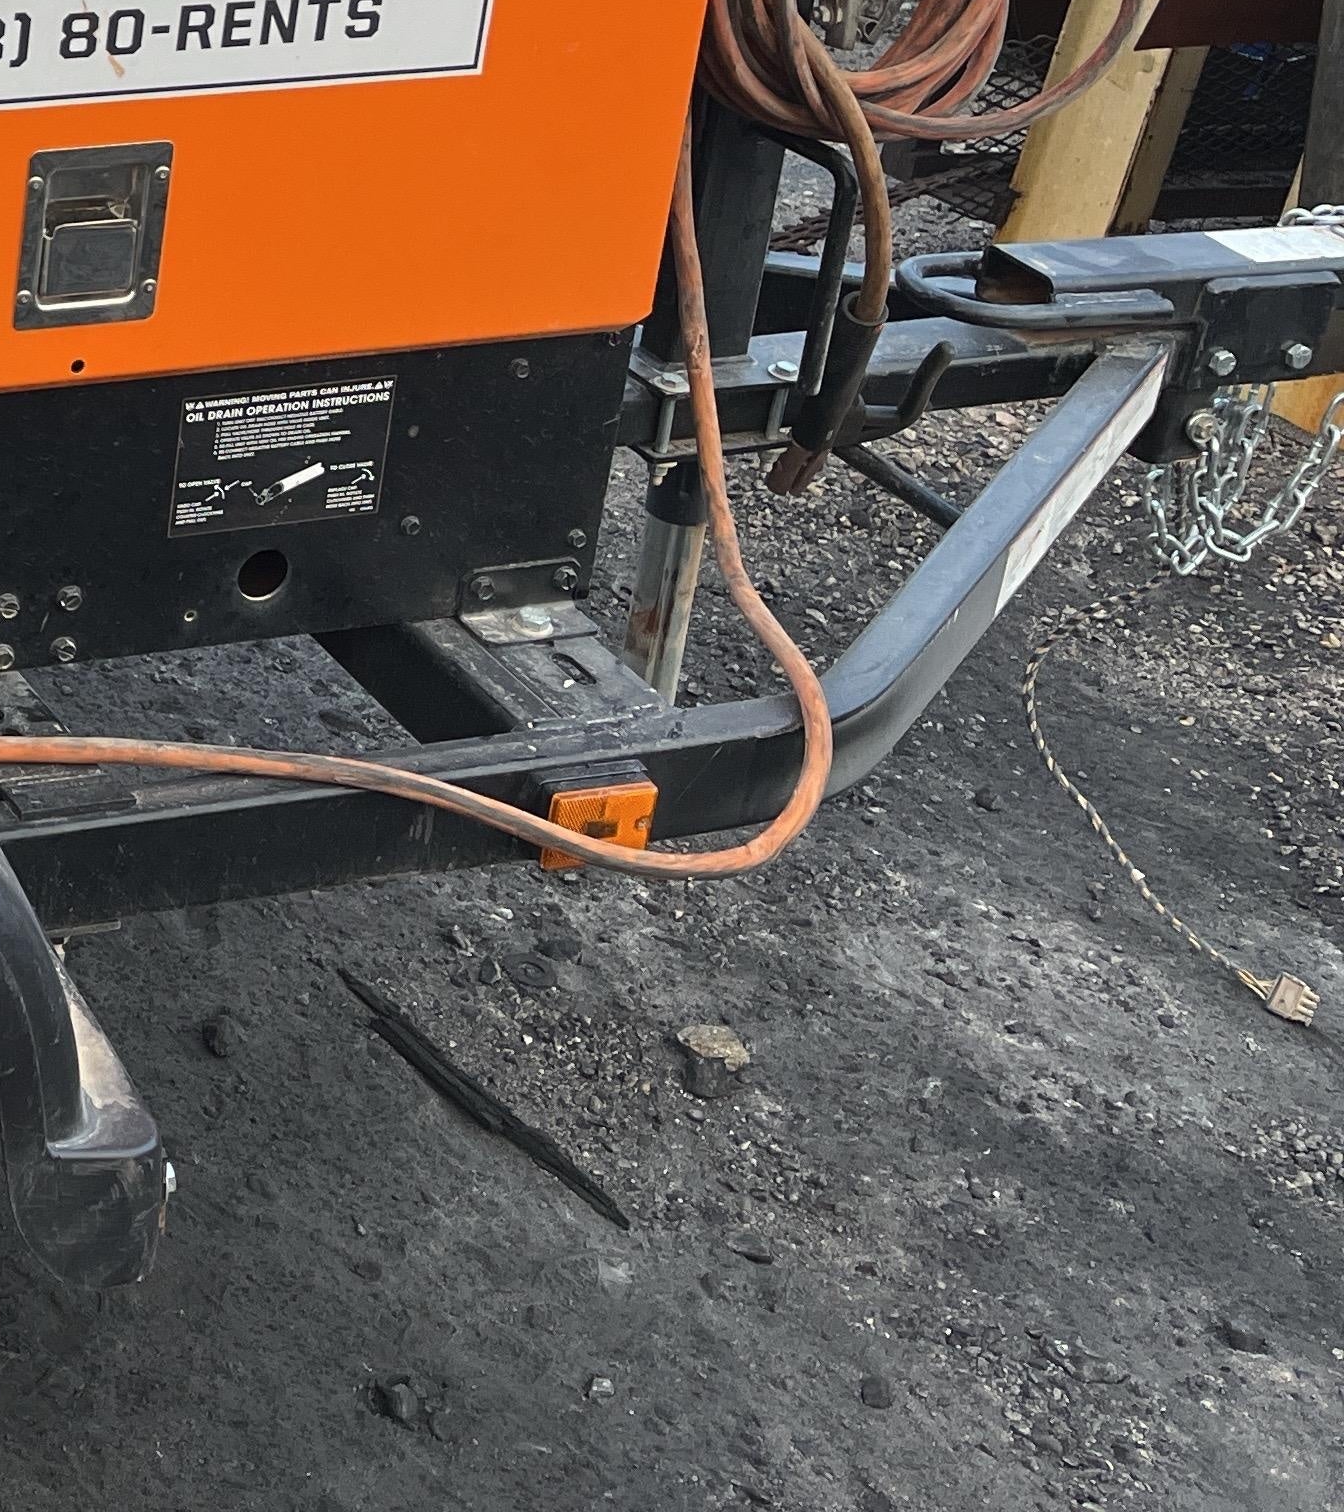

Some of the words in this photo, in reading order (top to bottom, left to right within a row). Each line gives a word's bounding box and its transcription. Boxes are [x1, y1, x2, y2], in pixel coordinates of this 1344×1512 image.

[184, 411, 205, 422] OIL
[206, 406, 243, 420] DRAIN
[245, 399, 311, 416] OPERATION
[311, 390, 391, 409] INSTRUCTIONS
[250, 391, 287, 402] MOVING
[288, 388, 318, 398] PARTS
[318, 386, 339, 395] CAN
